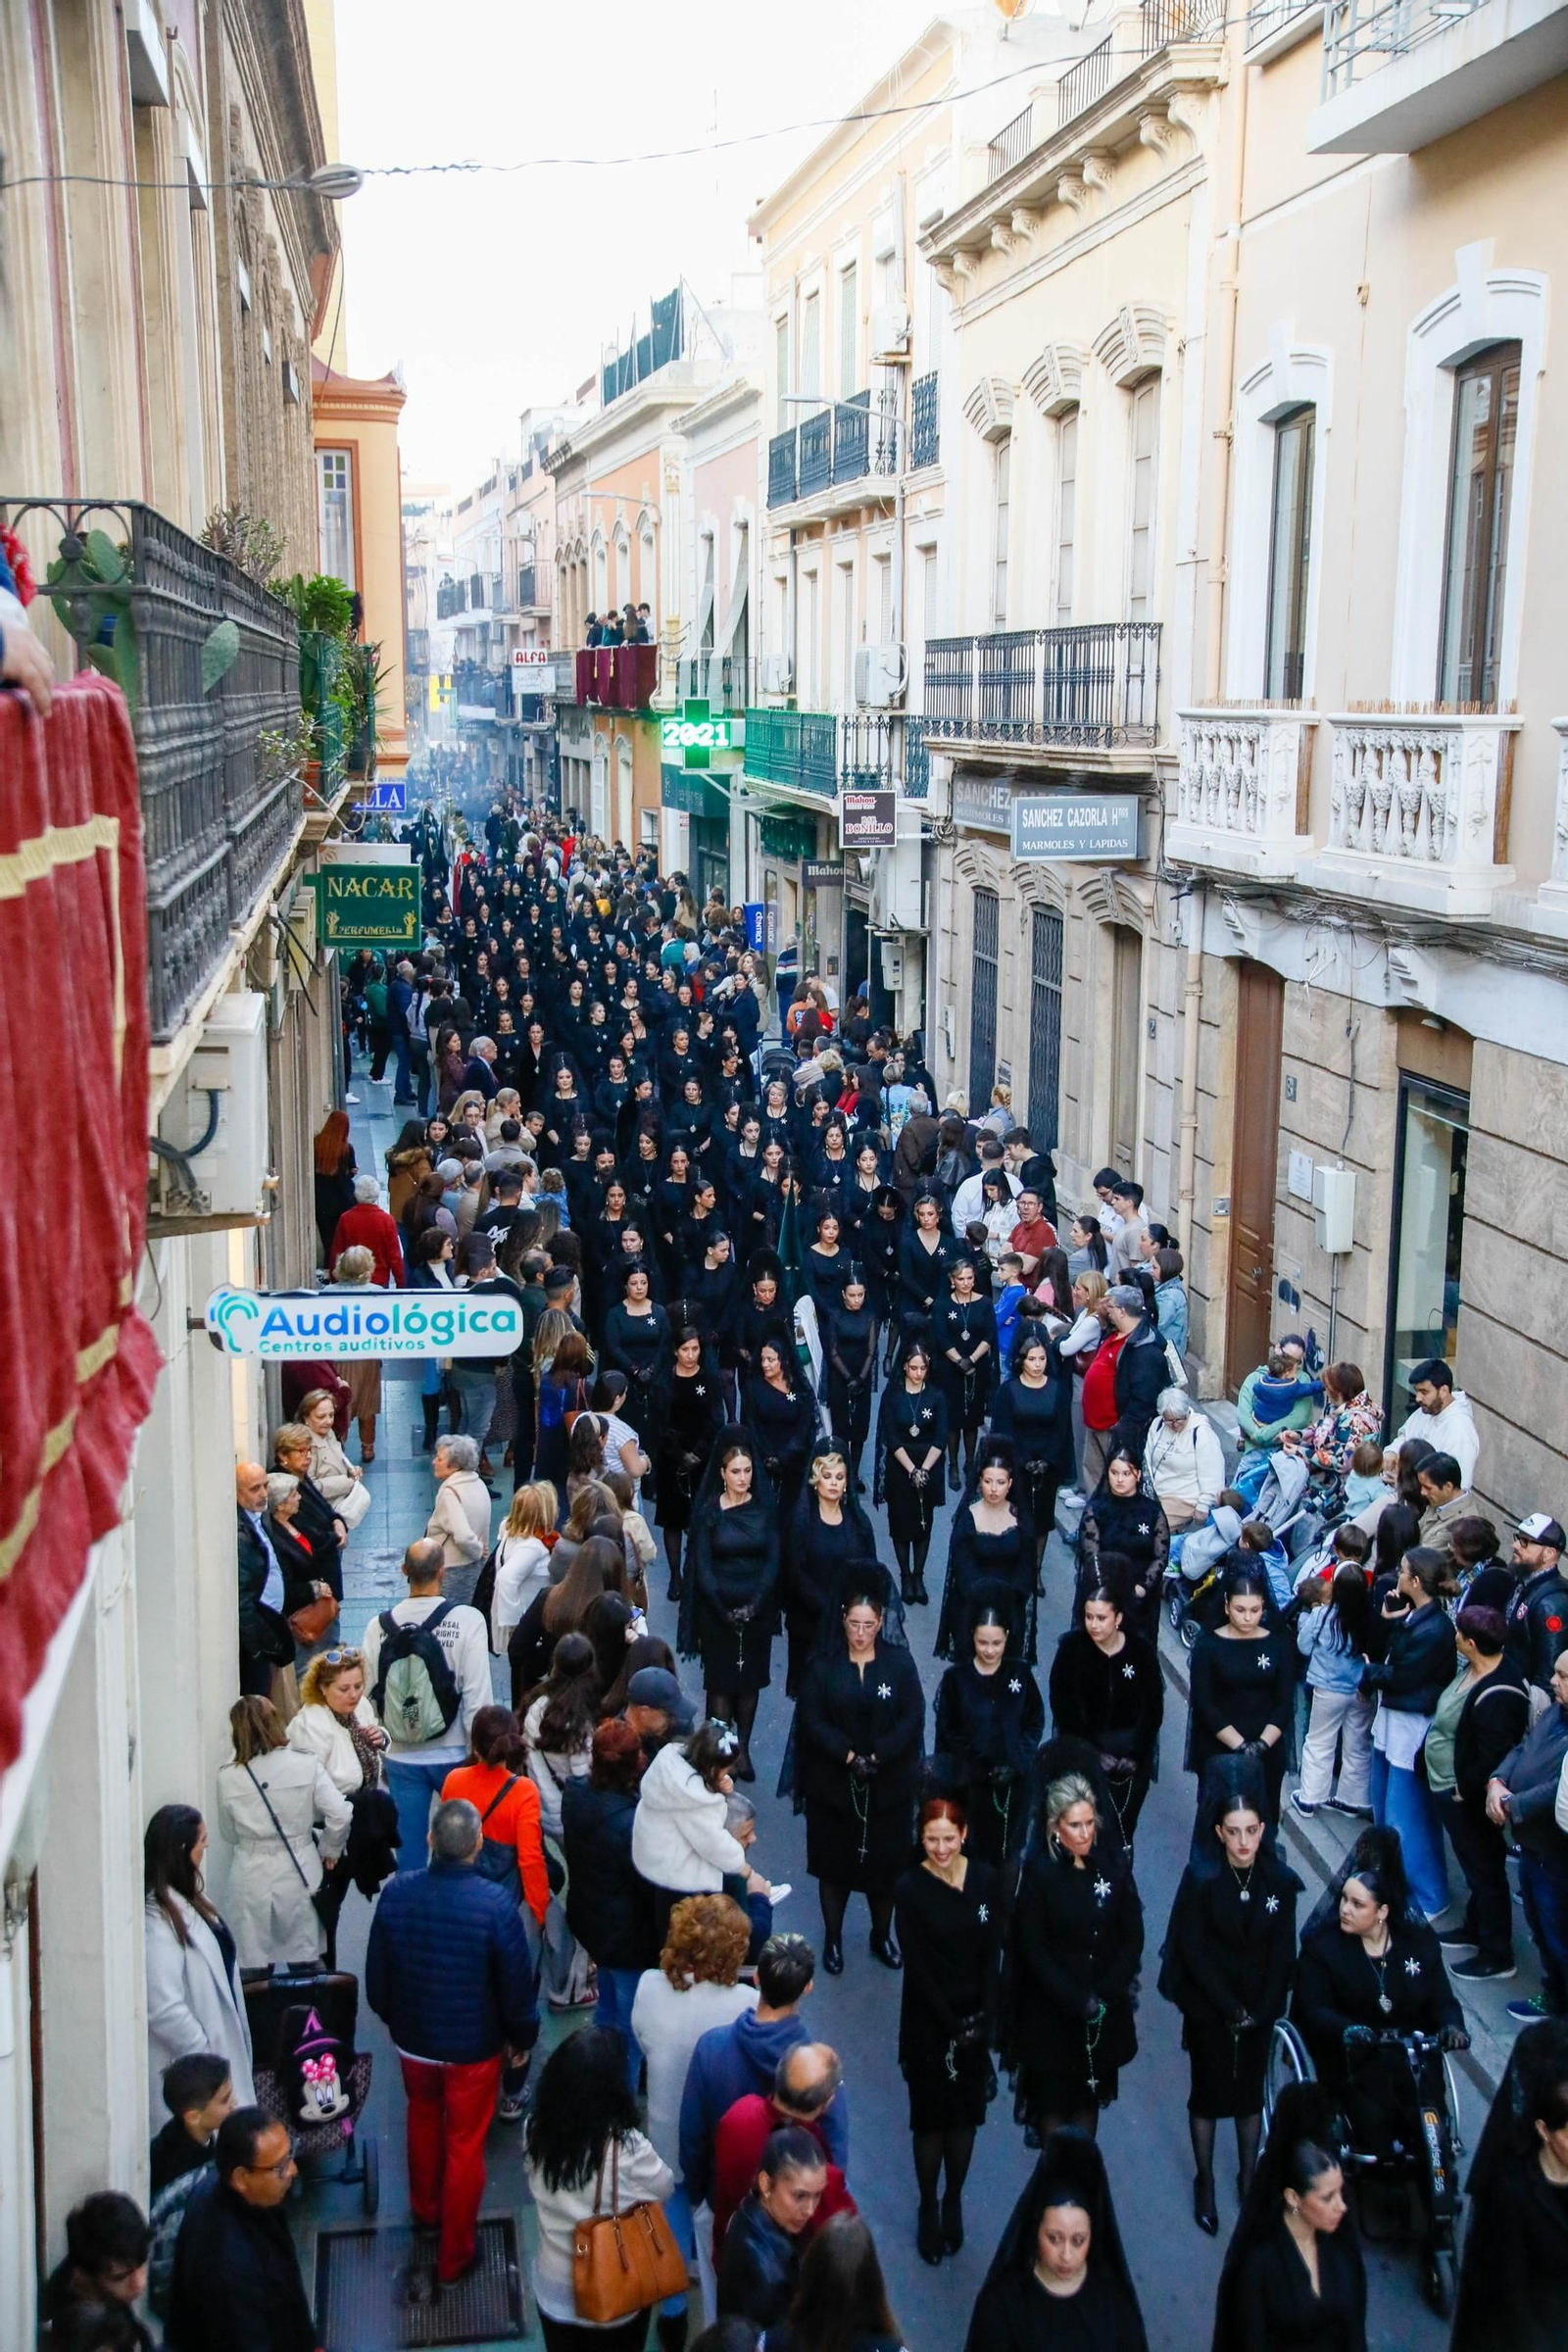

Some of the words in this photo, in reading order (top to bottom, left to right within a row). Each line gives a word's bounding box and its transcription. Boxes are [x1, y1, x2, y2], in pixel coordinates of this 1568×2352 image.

[515, 651, 546, 663] ALFA
[845, 795, 877, 805] Mahou
[956, 781, 1011, 810] SANCHEZ
[1022, 808, 1063, 828] SANCHEZ
[1067, 808, 1107, 827] CAZORLA
[845, 823, 893, 834] BONILLO
[1022, 840, 1074, 851] MARMOLES
[1079, 839, 1086, 849] Y
[1089, 838, 1128, 849] LAPIDAS
[327, 877, 415, 900] NACAR
[260, 1302, 515, 1345] Audiológica
[259, 1340, 333, 1353] Centros
[338, 1337, 425, 1351] auditivos
[436, 1630, 460, 1639] RIGHTS
[1424, 2112, 1442, 2168] Empulse
